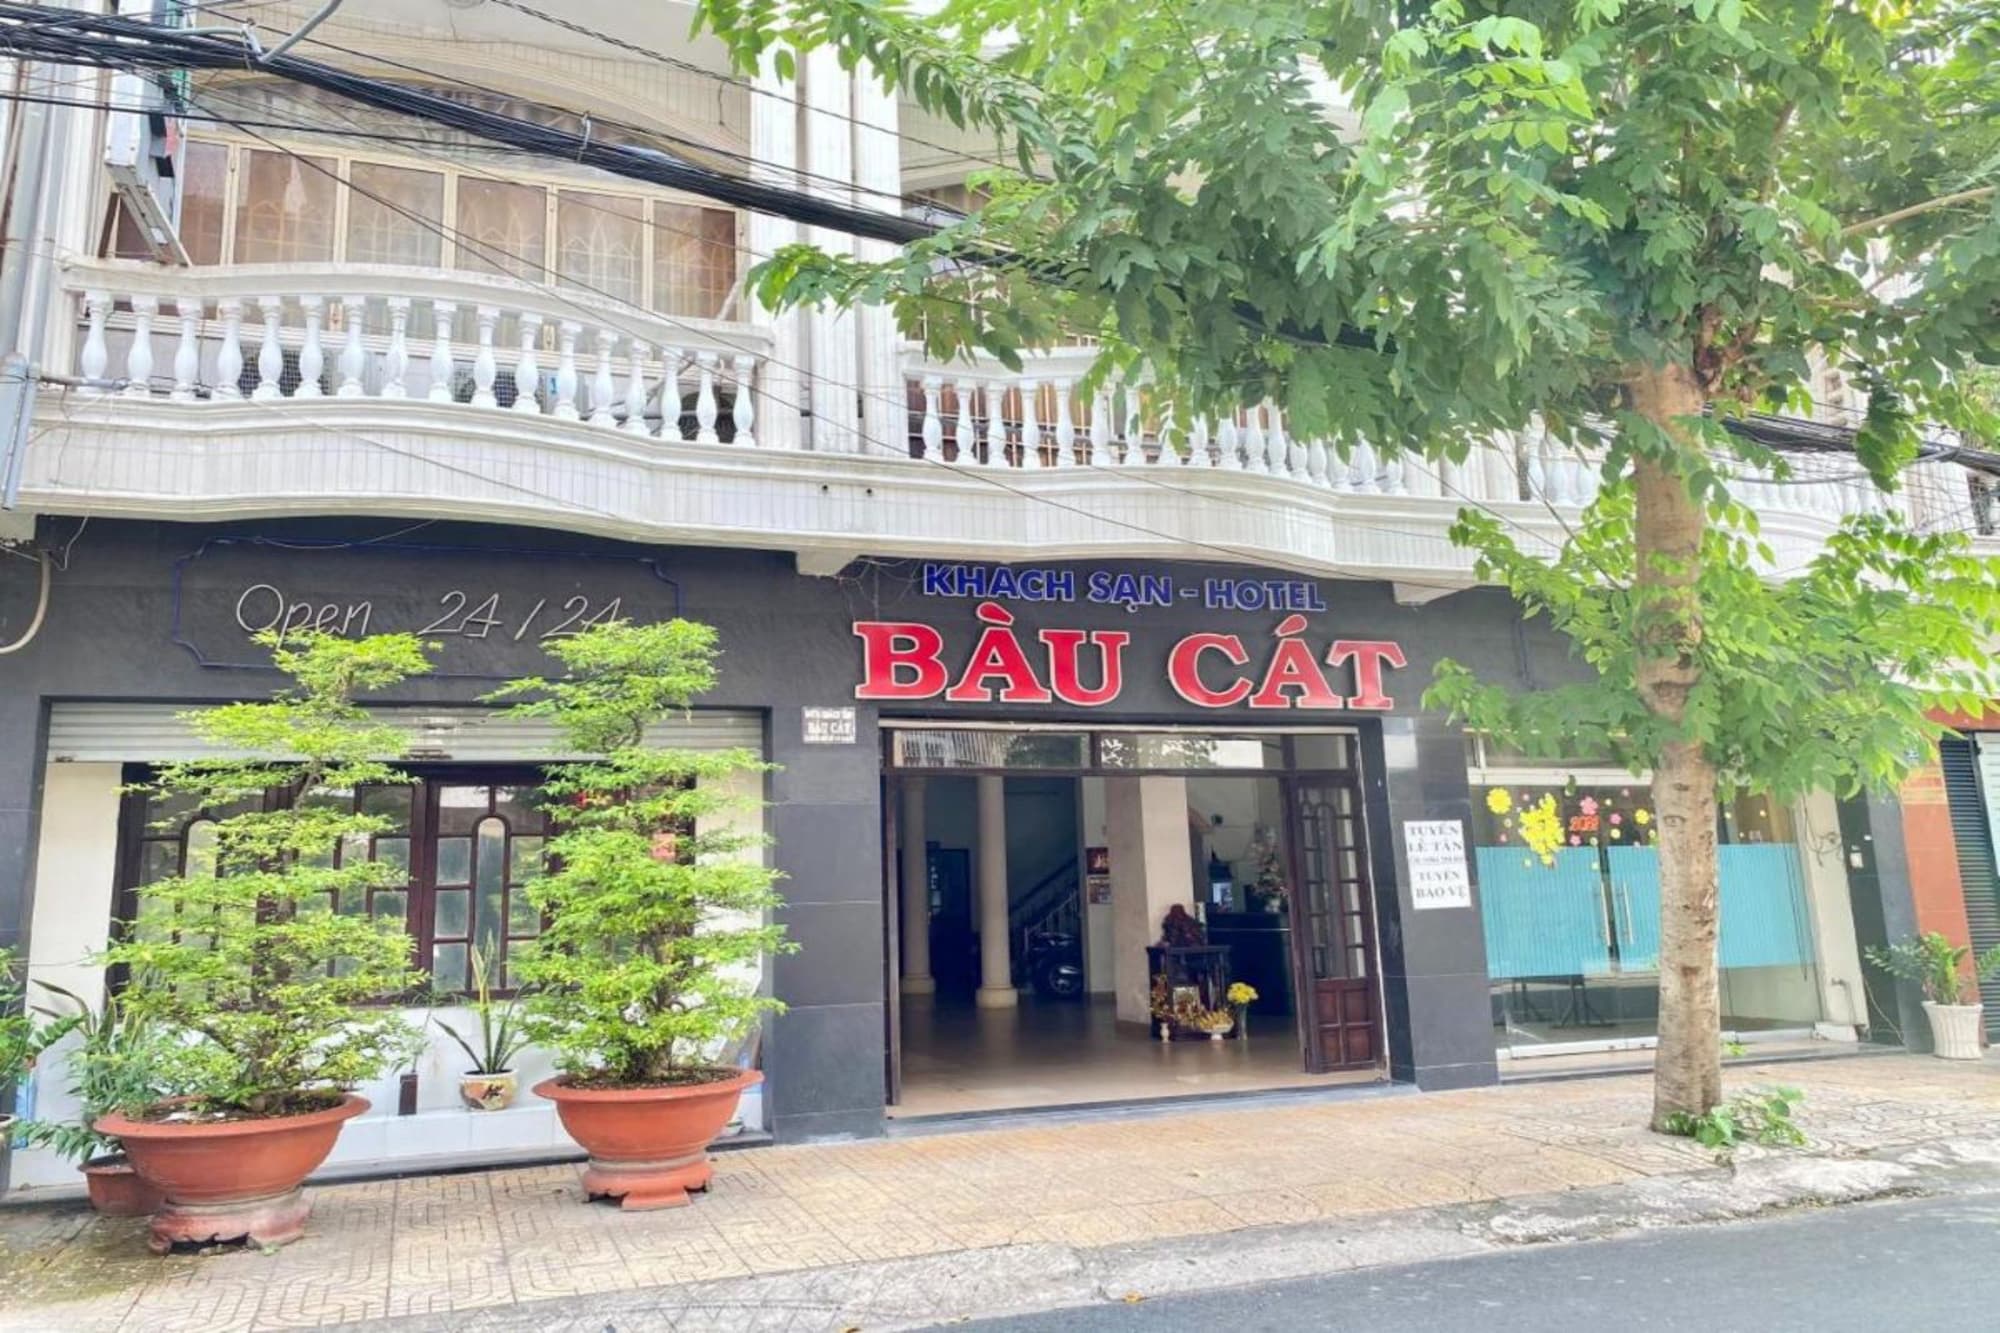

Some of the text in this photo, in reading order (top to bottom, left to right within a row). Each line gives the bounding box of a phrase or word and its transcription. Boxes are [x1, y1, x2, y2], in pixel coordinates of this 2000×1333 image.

[236, 583, 371, 651] Open
[924, 563, 1075, 602] KHACH
[1087, 571, 1173, 613] SẠN
[1204, 578, 1327, 613] HOTEL
[852, 602, 1408, 710] BÀU CÁT
